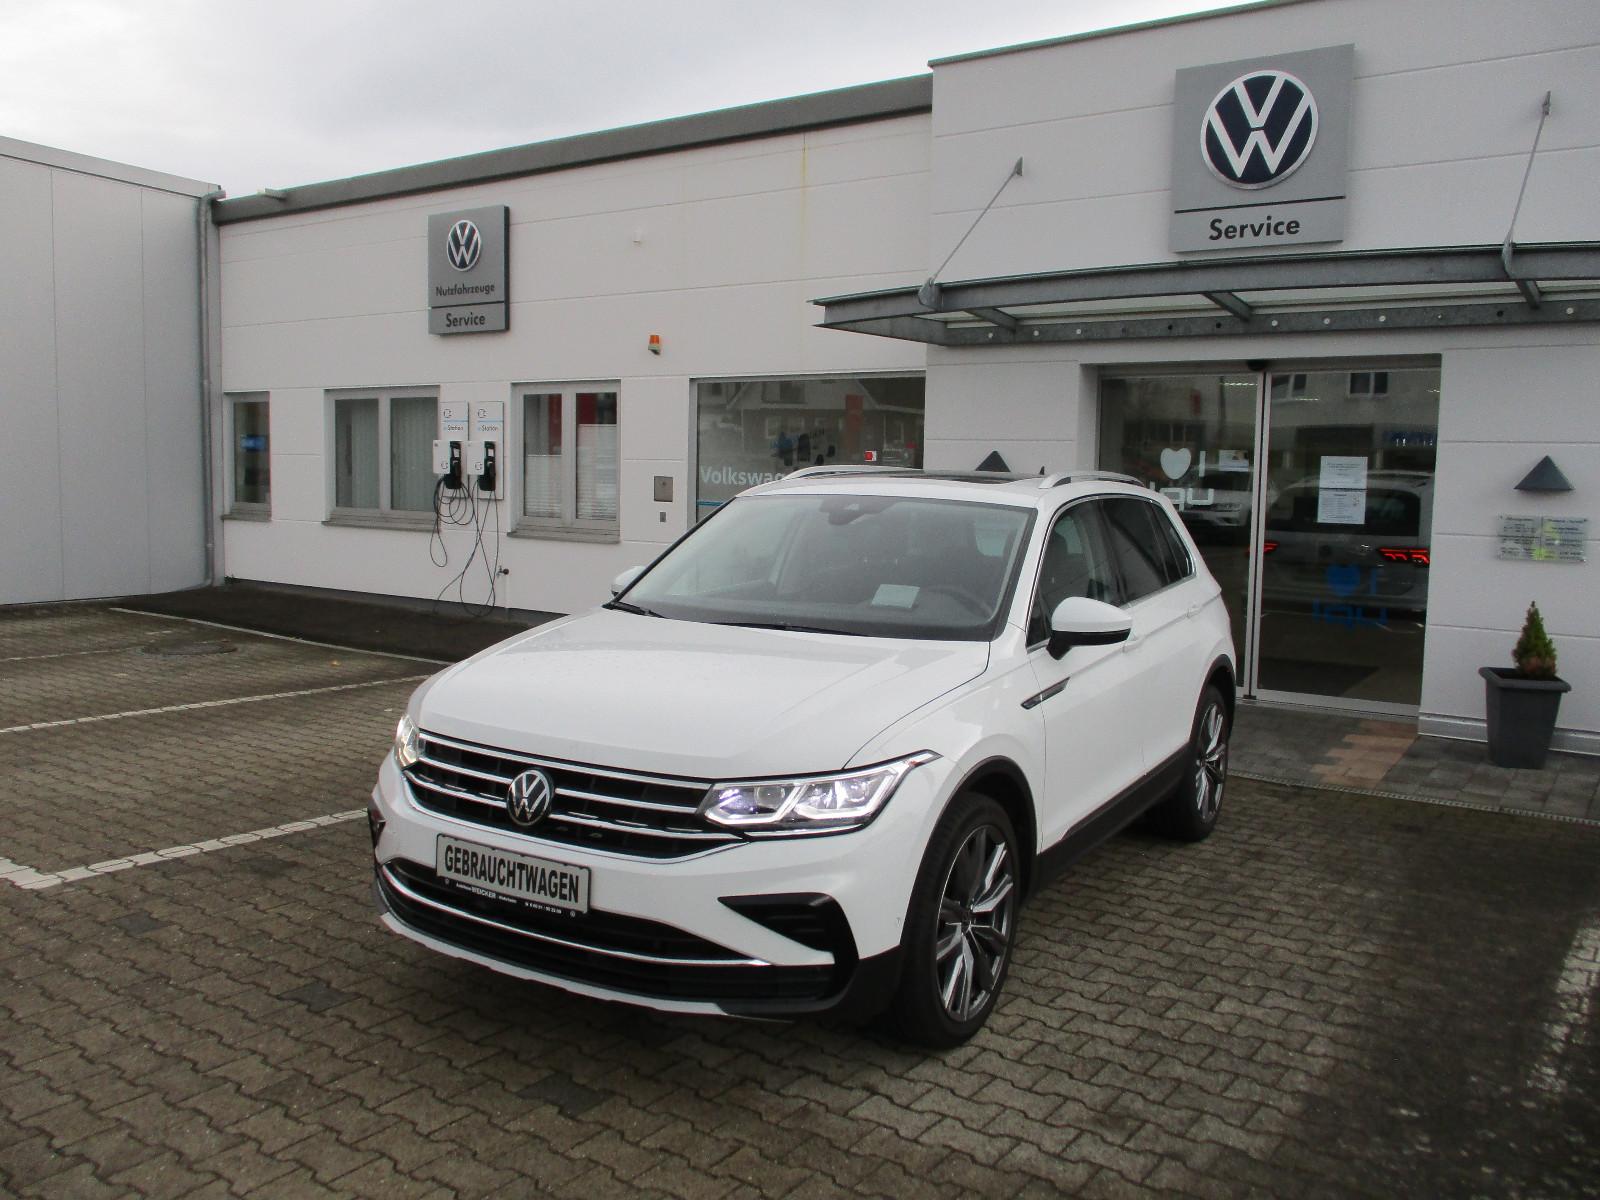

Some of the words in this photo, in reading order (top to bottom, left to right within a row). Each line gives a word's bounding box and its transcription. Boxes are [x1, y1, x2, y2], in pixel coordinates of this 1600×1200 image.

[1209, 215, 1300, 241] Service
[435, 283, 495, 297] Nutzfahrzeuge
[446, 312, 486, 328] Service
[444, 844, 580, 903] GEBRAUCHTWAGEN
